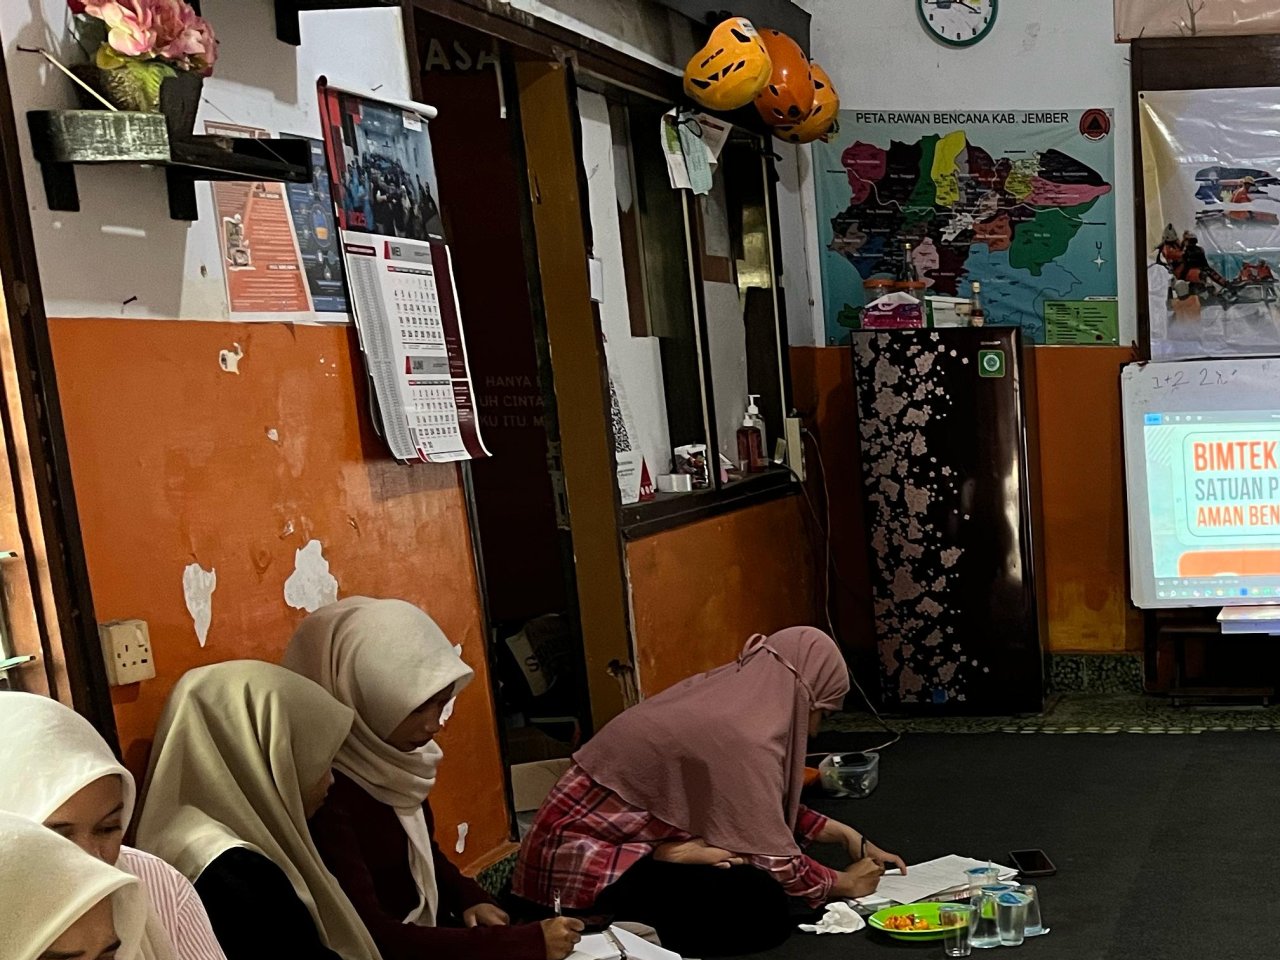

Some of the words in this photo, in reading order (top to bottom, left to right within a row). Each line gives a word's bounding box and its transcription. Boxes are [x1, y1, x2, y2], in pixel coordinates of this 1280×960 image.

[856, 112, 887, 123] PETA
[888, 112, 930, 124] RAWAN
[933, 112, 990, 124] BENCANA
[992, 112, 1019, 124] KAB.
[1022, 112, 1069, 124] JEMBER
[1193, 440, 1278, 472] BIMTEK
[1194, 476, 1263, 501] SATUAN
[1197, 505, 1244, 528] AMAN
